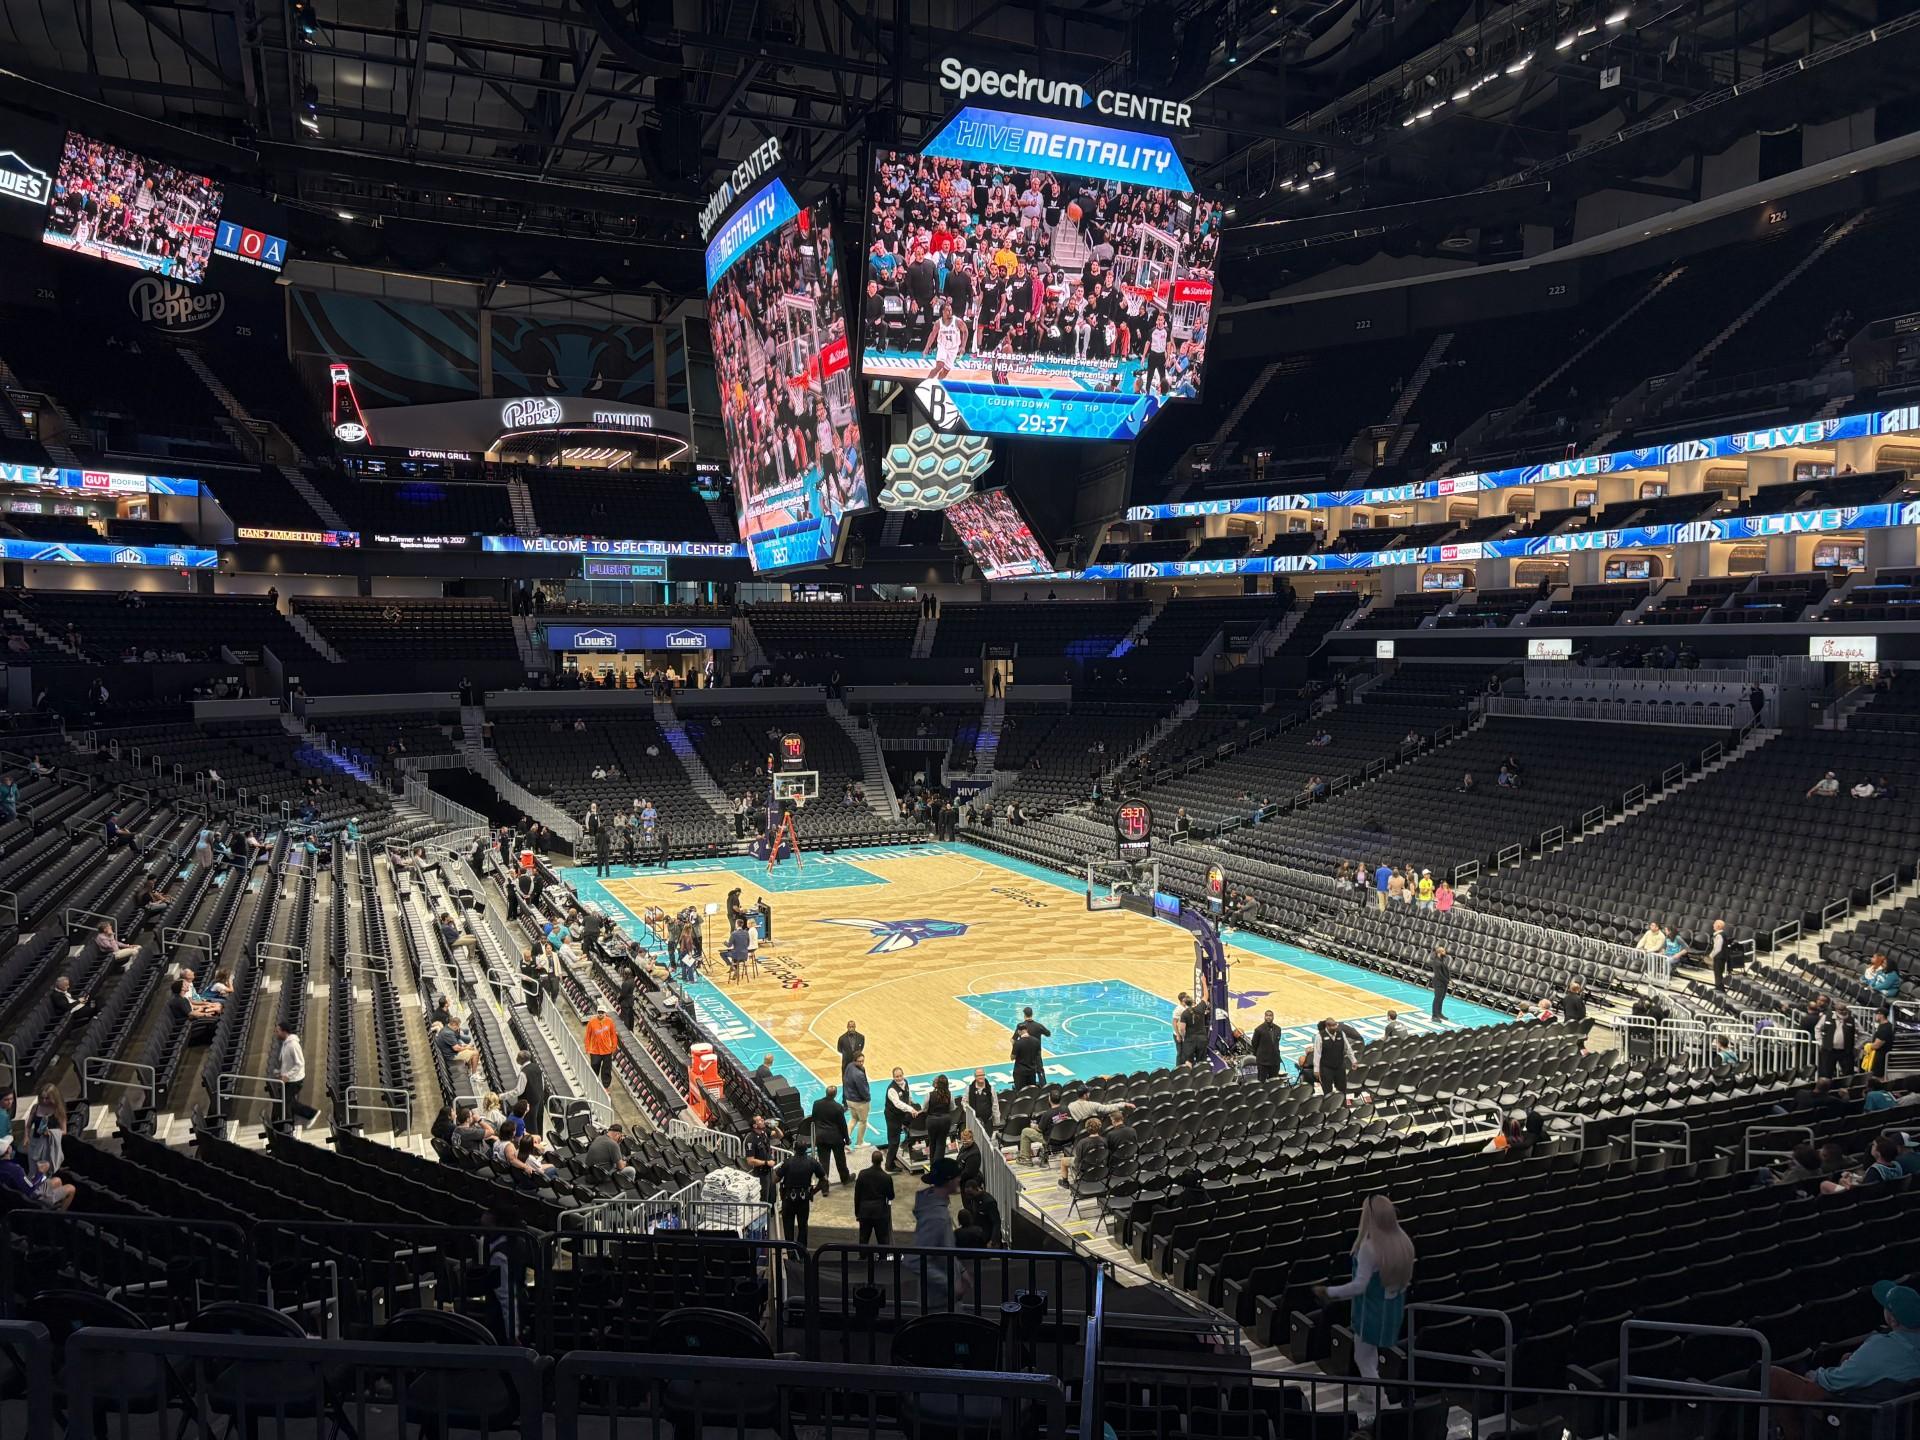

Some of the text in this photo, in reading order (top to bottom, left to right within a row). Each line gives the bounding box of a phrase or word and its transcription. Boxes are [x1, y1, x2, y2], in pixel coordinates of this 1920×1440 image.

[939, 57, 1192, 128] Spectrum CENTER
[956, 120, 1172, 174] HIVE MENTALITY
[699, 136, 782, 243] Spectrum CENTER
[1770, 210, 1787, 224] 224
[720, 192, 776, 262] MENTALITY
[1549, 285, 1566, 296] 223
[129, 277, 217, 326] Pepper
[1356, 320, 1371, 329] 222
[976, 349, 996, 359] Last
[1030, 354, 1046, 364] the
[1046, 355, 1078, 366] Hornets
[1078, 358, 1099, 367] were
[1099, 358, 1119, 370] third
[977, 363, 994, 373] the
[994, 363, 1014, 374] NBA
[1071, 369, 1112, 382] percentage
[1112, 372, 1123, 381] at
[524, 399, 545, 413] Dr
[987, 397, 1100, 413] COUNTDOWN TO TIP
[503, 400, 562, 428] Pepper
[594, 412, 652, 429] PAVILION
[1016, 413, 1070, 434] 29:37
[1746, 421, 1825, 451] LIVE
[408, 449, 472, 461] UPTOWN GRILL
[696, 463, 720, 472] BRIXX
[1543, 457, 1599, 479] LIVE
[85, 474, 109, 486] GUY
[111, 477, 145, 488] ROOFING
[1440, 481, 1454, 493] GUY
[1364, 484, 1414, 504] LIVE
[1180, 500, 1231, 516] LIVE
[1760, 509, 1842, 535] LIVE
[238, 527, 322, 542] HANS ZIMMER LIVE
[374, 534, 466, 546] Hans Zimmer March 9, 2027
[1550, 532, 1606, 551] LIVE
[522, 538, 733, 556] WELCOME TO SPECTRUM CENTER
[1443, 546, 1457, 558] GUY
[115, 549, 143, 564] BUZZ
[1372, 548, 1417, 567] LIVE
[589, 564, 664, 576] FLIGHT DECK
[1184, 559, 1237, 575] LIVE
[578, 635, 613, 647] LOWE'S
[670, 635, 703, 647] LOWE'S
[790, 744, 800, 756] 14
[1120, 807, 1145, 818] 29:37
[1129, 816, 1143, 836] 14
[1127, 841, 1150, 850] TISSOT
[1194, 967, 1202, 1006] bet36
